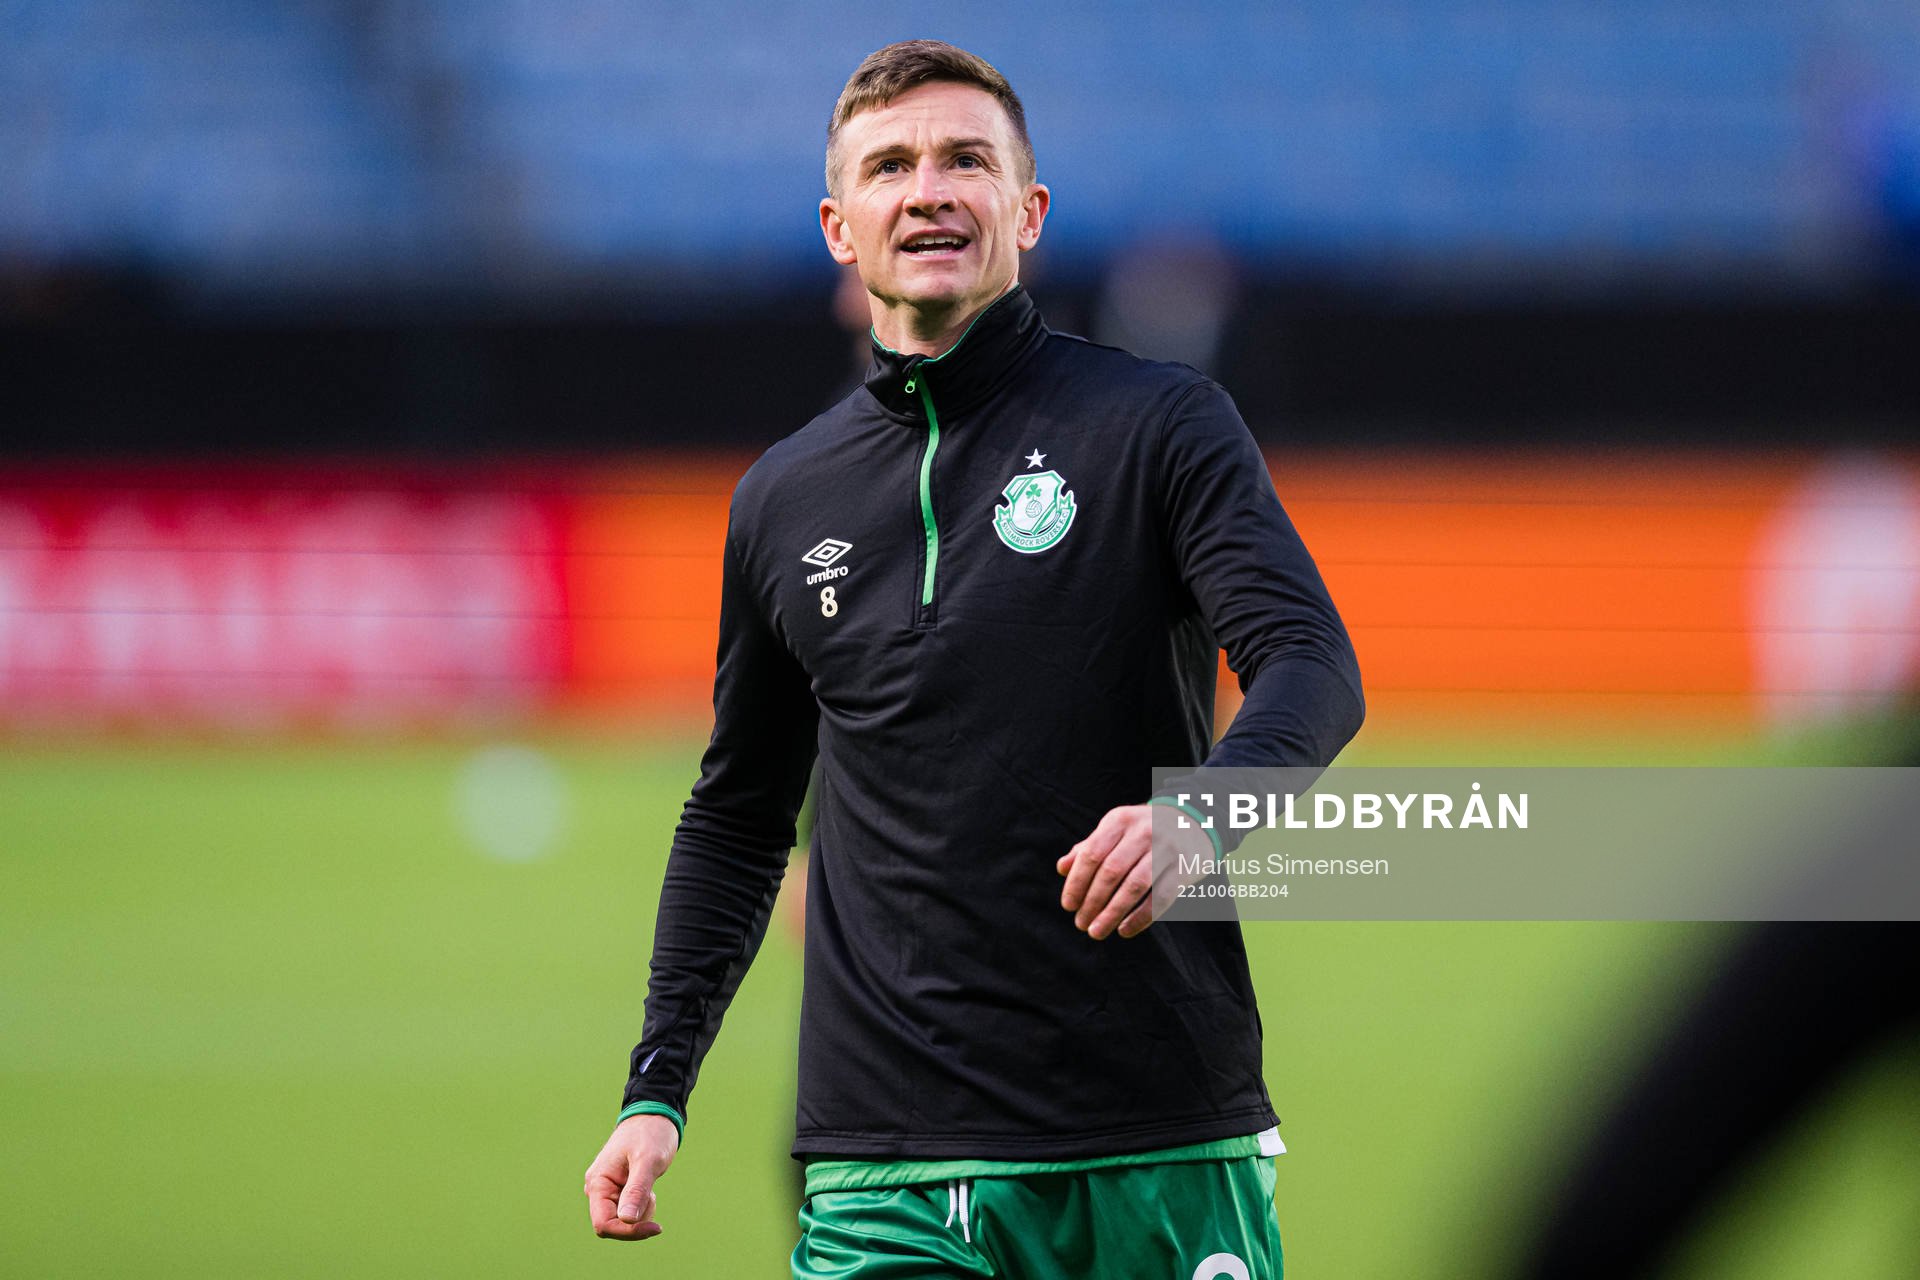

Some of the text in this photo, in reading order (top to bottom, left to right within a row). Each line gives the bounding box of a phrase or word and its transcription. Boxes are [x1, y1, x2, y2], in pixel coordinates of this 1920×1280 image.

[1002, 522, 1034, 546] SHAMROCK
[1035, 526, 1061, 545] ROVERS
[806, 566, 849, 585] umbro
[820, 586, 838, 617] 8
